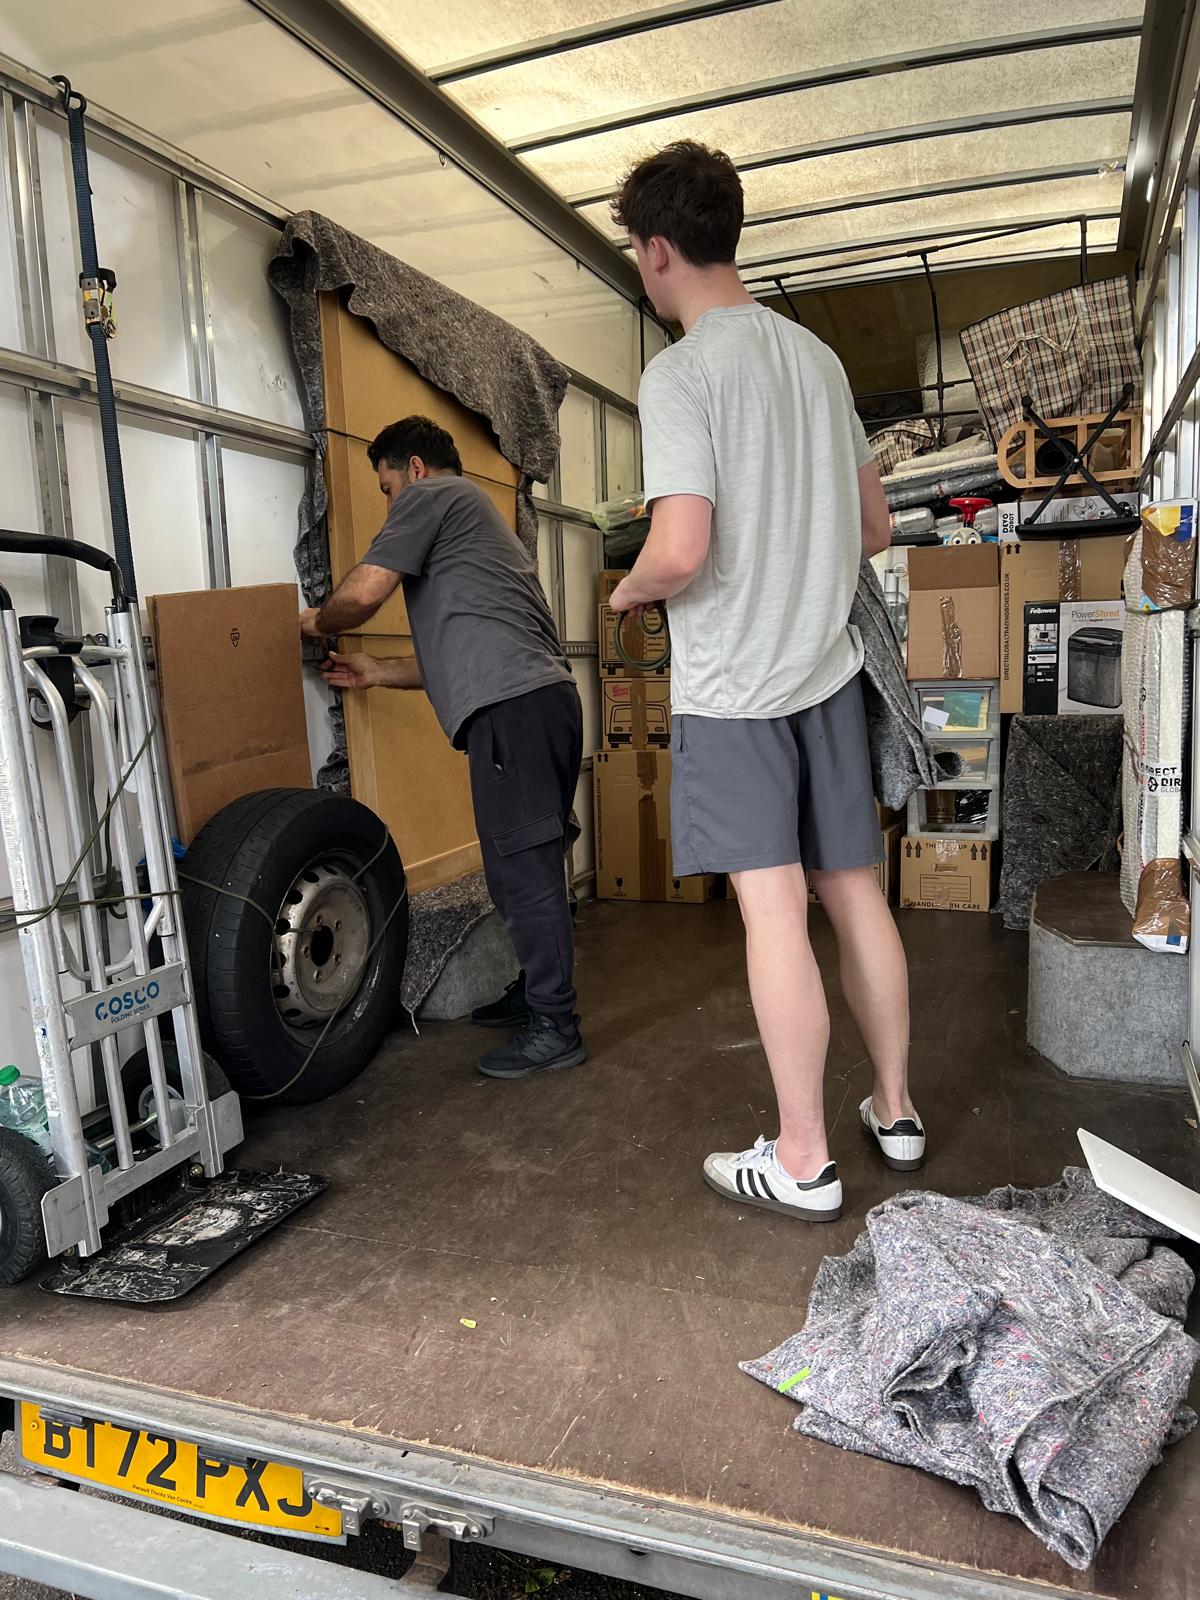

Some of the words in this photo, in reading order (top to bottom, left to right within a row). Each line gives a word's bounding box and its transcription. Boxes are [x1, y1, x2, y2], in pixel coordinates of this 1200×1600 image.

[1029, 607, 1057, 615] Fellowes
[1071, 609, 1120, 619] PowerShred
[962, 903, 980, 911] CARE
[95, 980, 160, 1021] COSCO
[43, 1416, 177, 1491] BT72
[150, 1489, 166, 1498] Trucks
